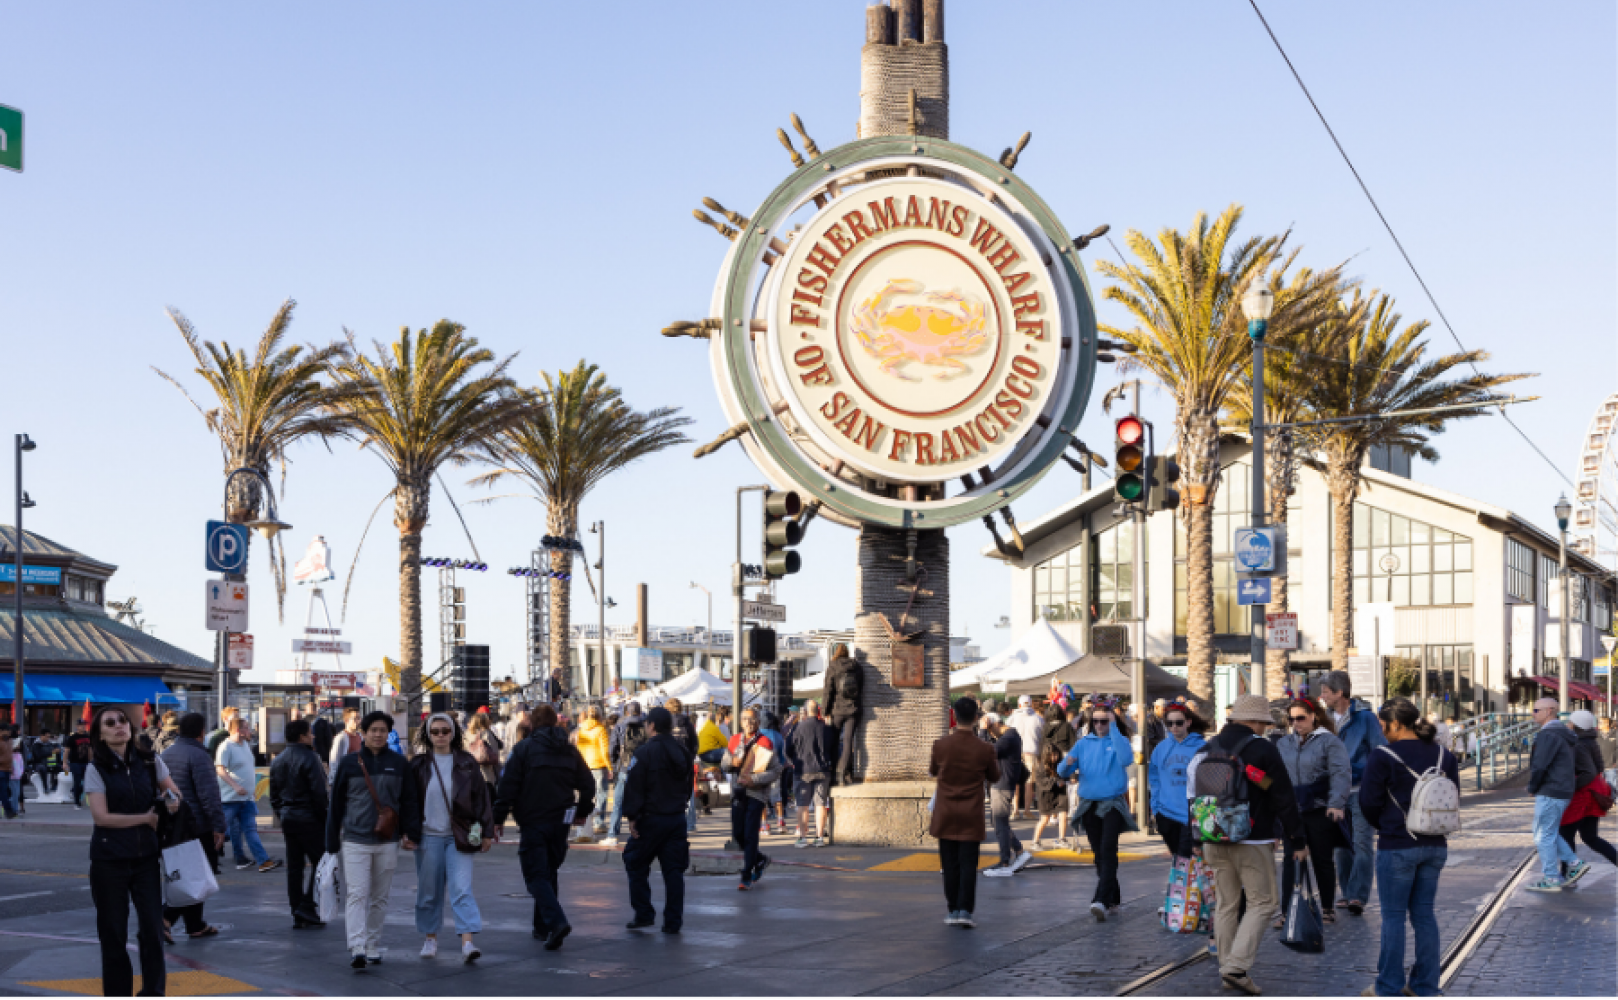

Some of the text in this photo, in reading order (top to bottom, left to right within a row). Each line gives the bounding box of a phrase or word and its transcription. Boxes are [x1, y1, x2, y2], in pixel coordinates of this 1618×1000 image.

[790, 195, 1044, 341] FISHERMANS WHARF
[794, 345, 1041, 465] OF SAN FRANCISCO
[218, 533, 238, 561] P
